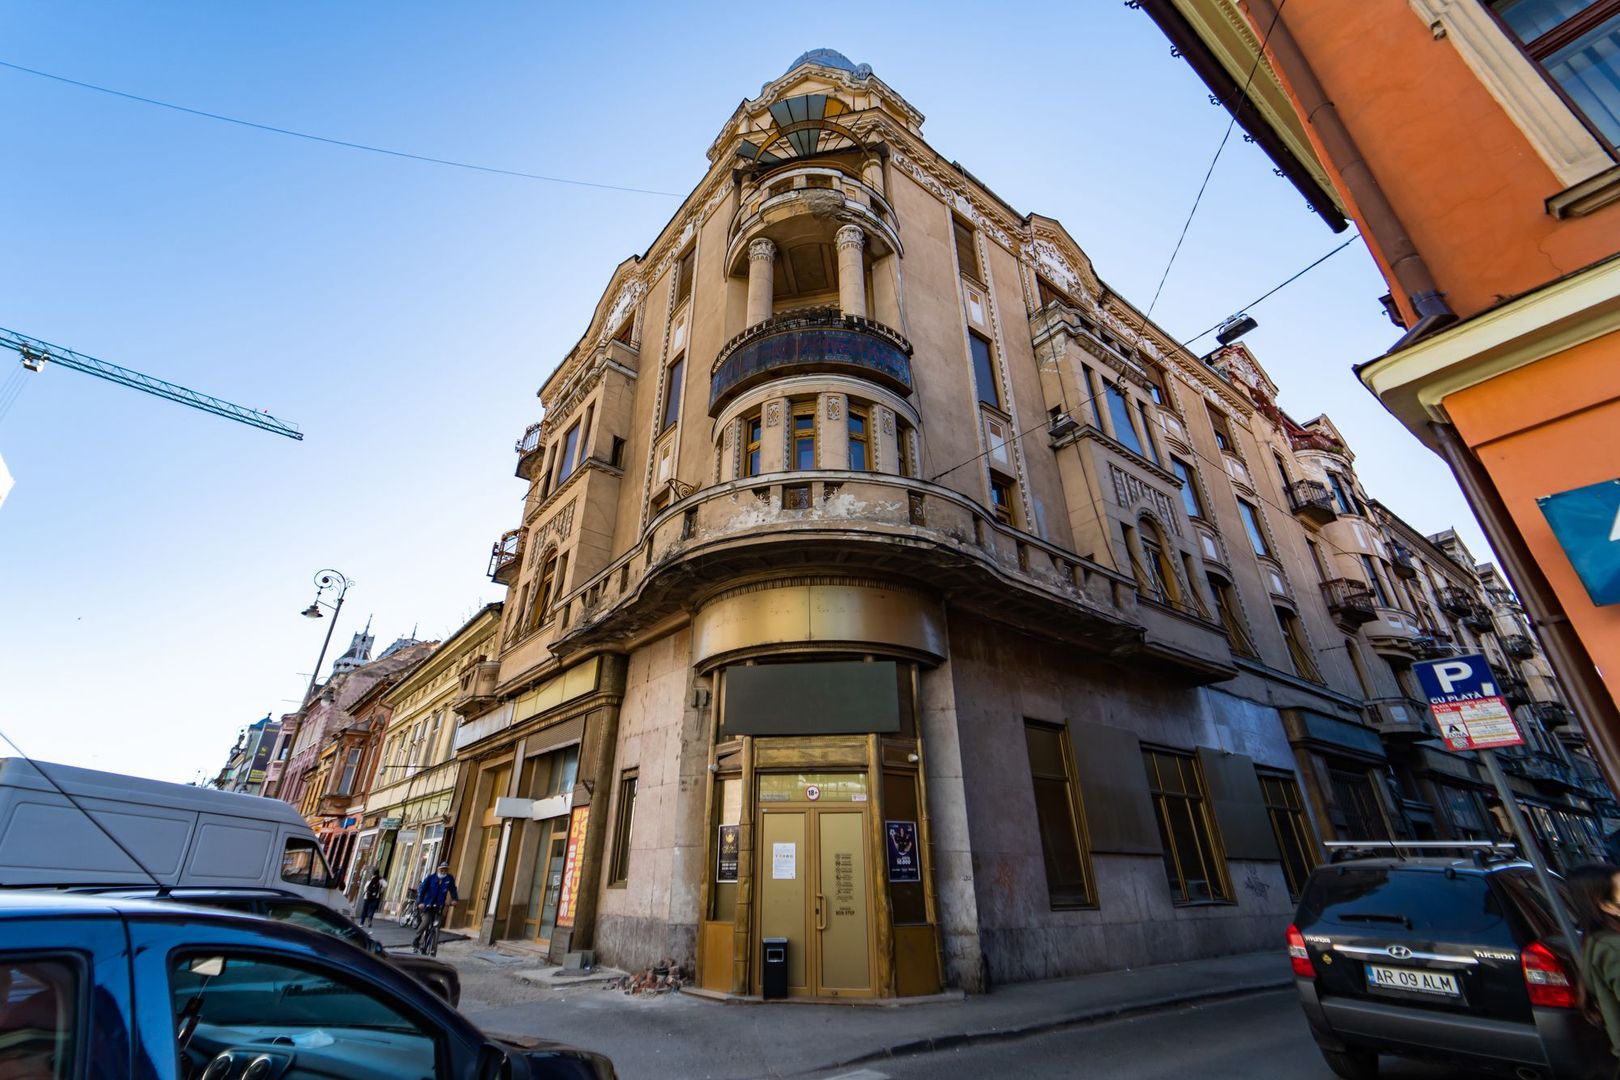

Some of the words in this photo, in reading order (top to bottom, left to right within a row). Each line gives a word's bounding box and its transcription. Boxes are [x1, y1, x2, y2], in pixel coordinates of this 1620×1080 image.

[1432, 661, 1473, 693] P
[1448, 724, 1460, 733] A
[808, 789, 818, 797] 18+
[571, 808, 583, 838] DE
[1376, 969, 1395, 984] AR
[1399, 971, 1418, 987] 09
[1422, 974, 1453, 991] ALM
